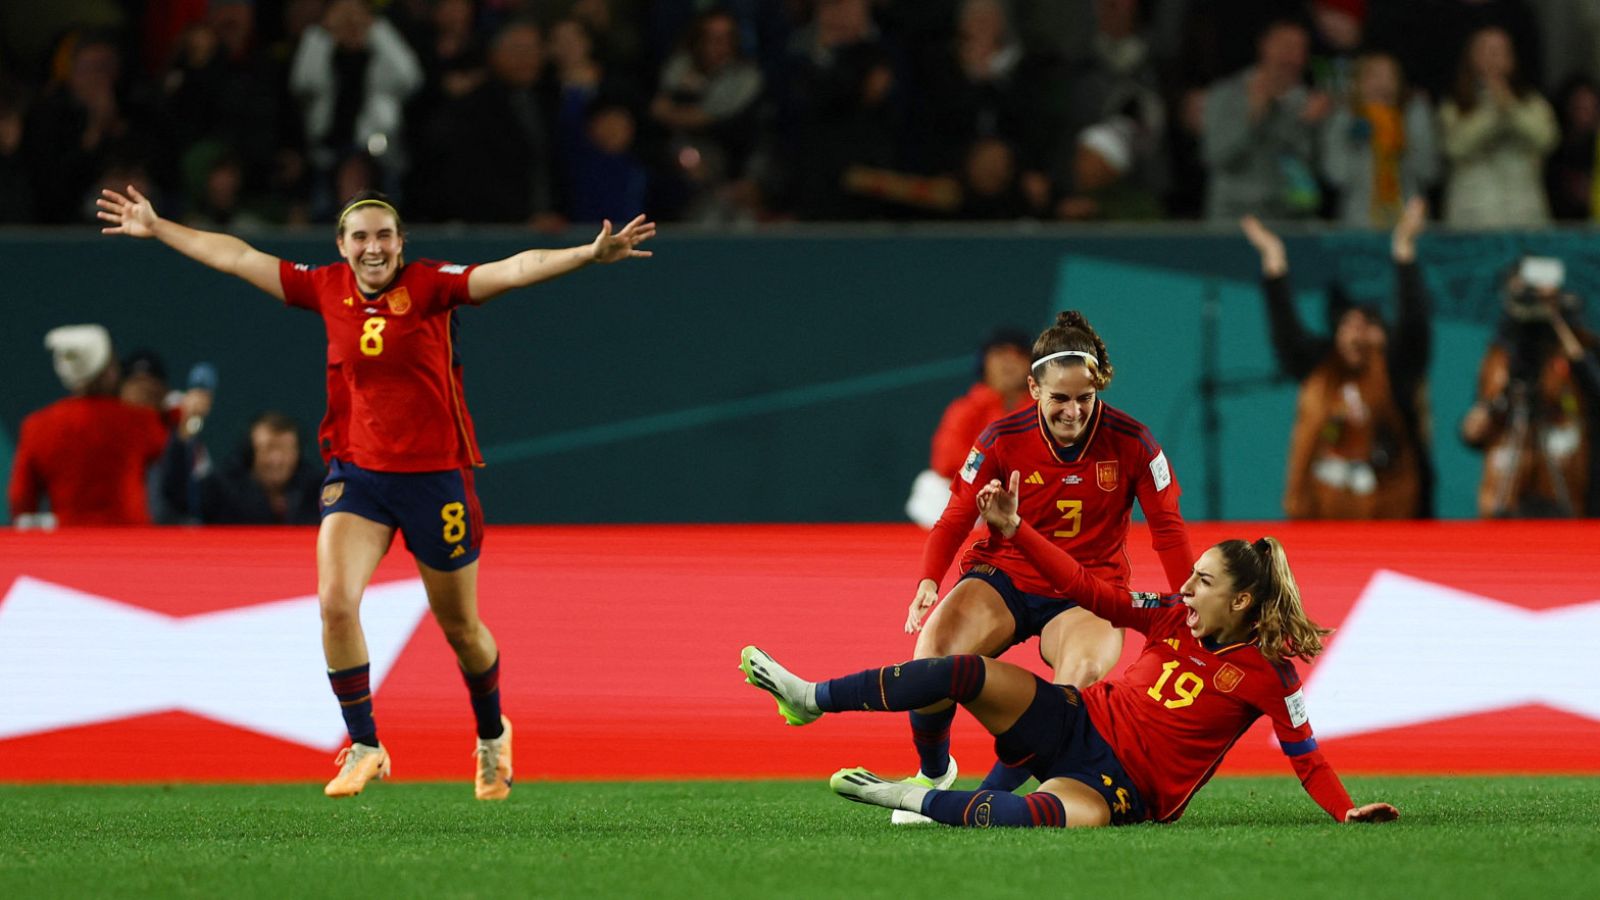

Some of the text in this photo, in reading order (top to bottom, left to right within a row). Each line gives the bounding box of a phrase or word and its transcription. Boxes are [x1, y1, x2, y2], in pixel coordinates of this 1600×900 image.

[359, 316, 387, 356] 8
[441, 501, 466, 544] 8
[1054, 499, 1083, 538] 3
[1146, 659, 1205, 709] 19
